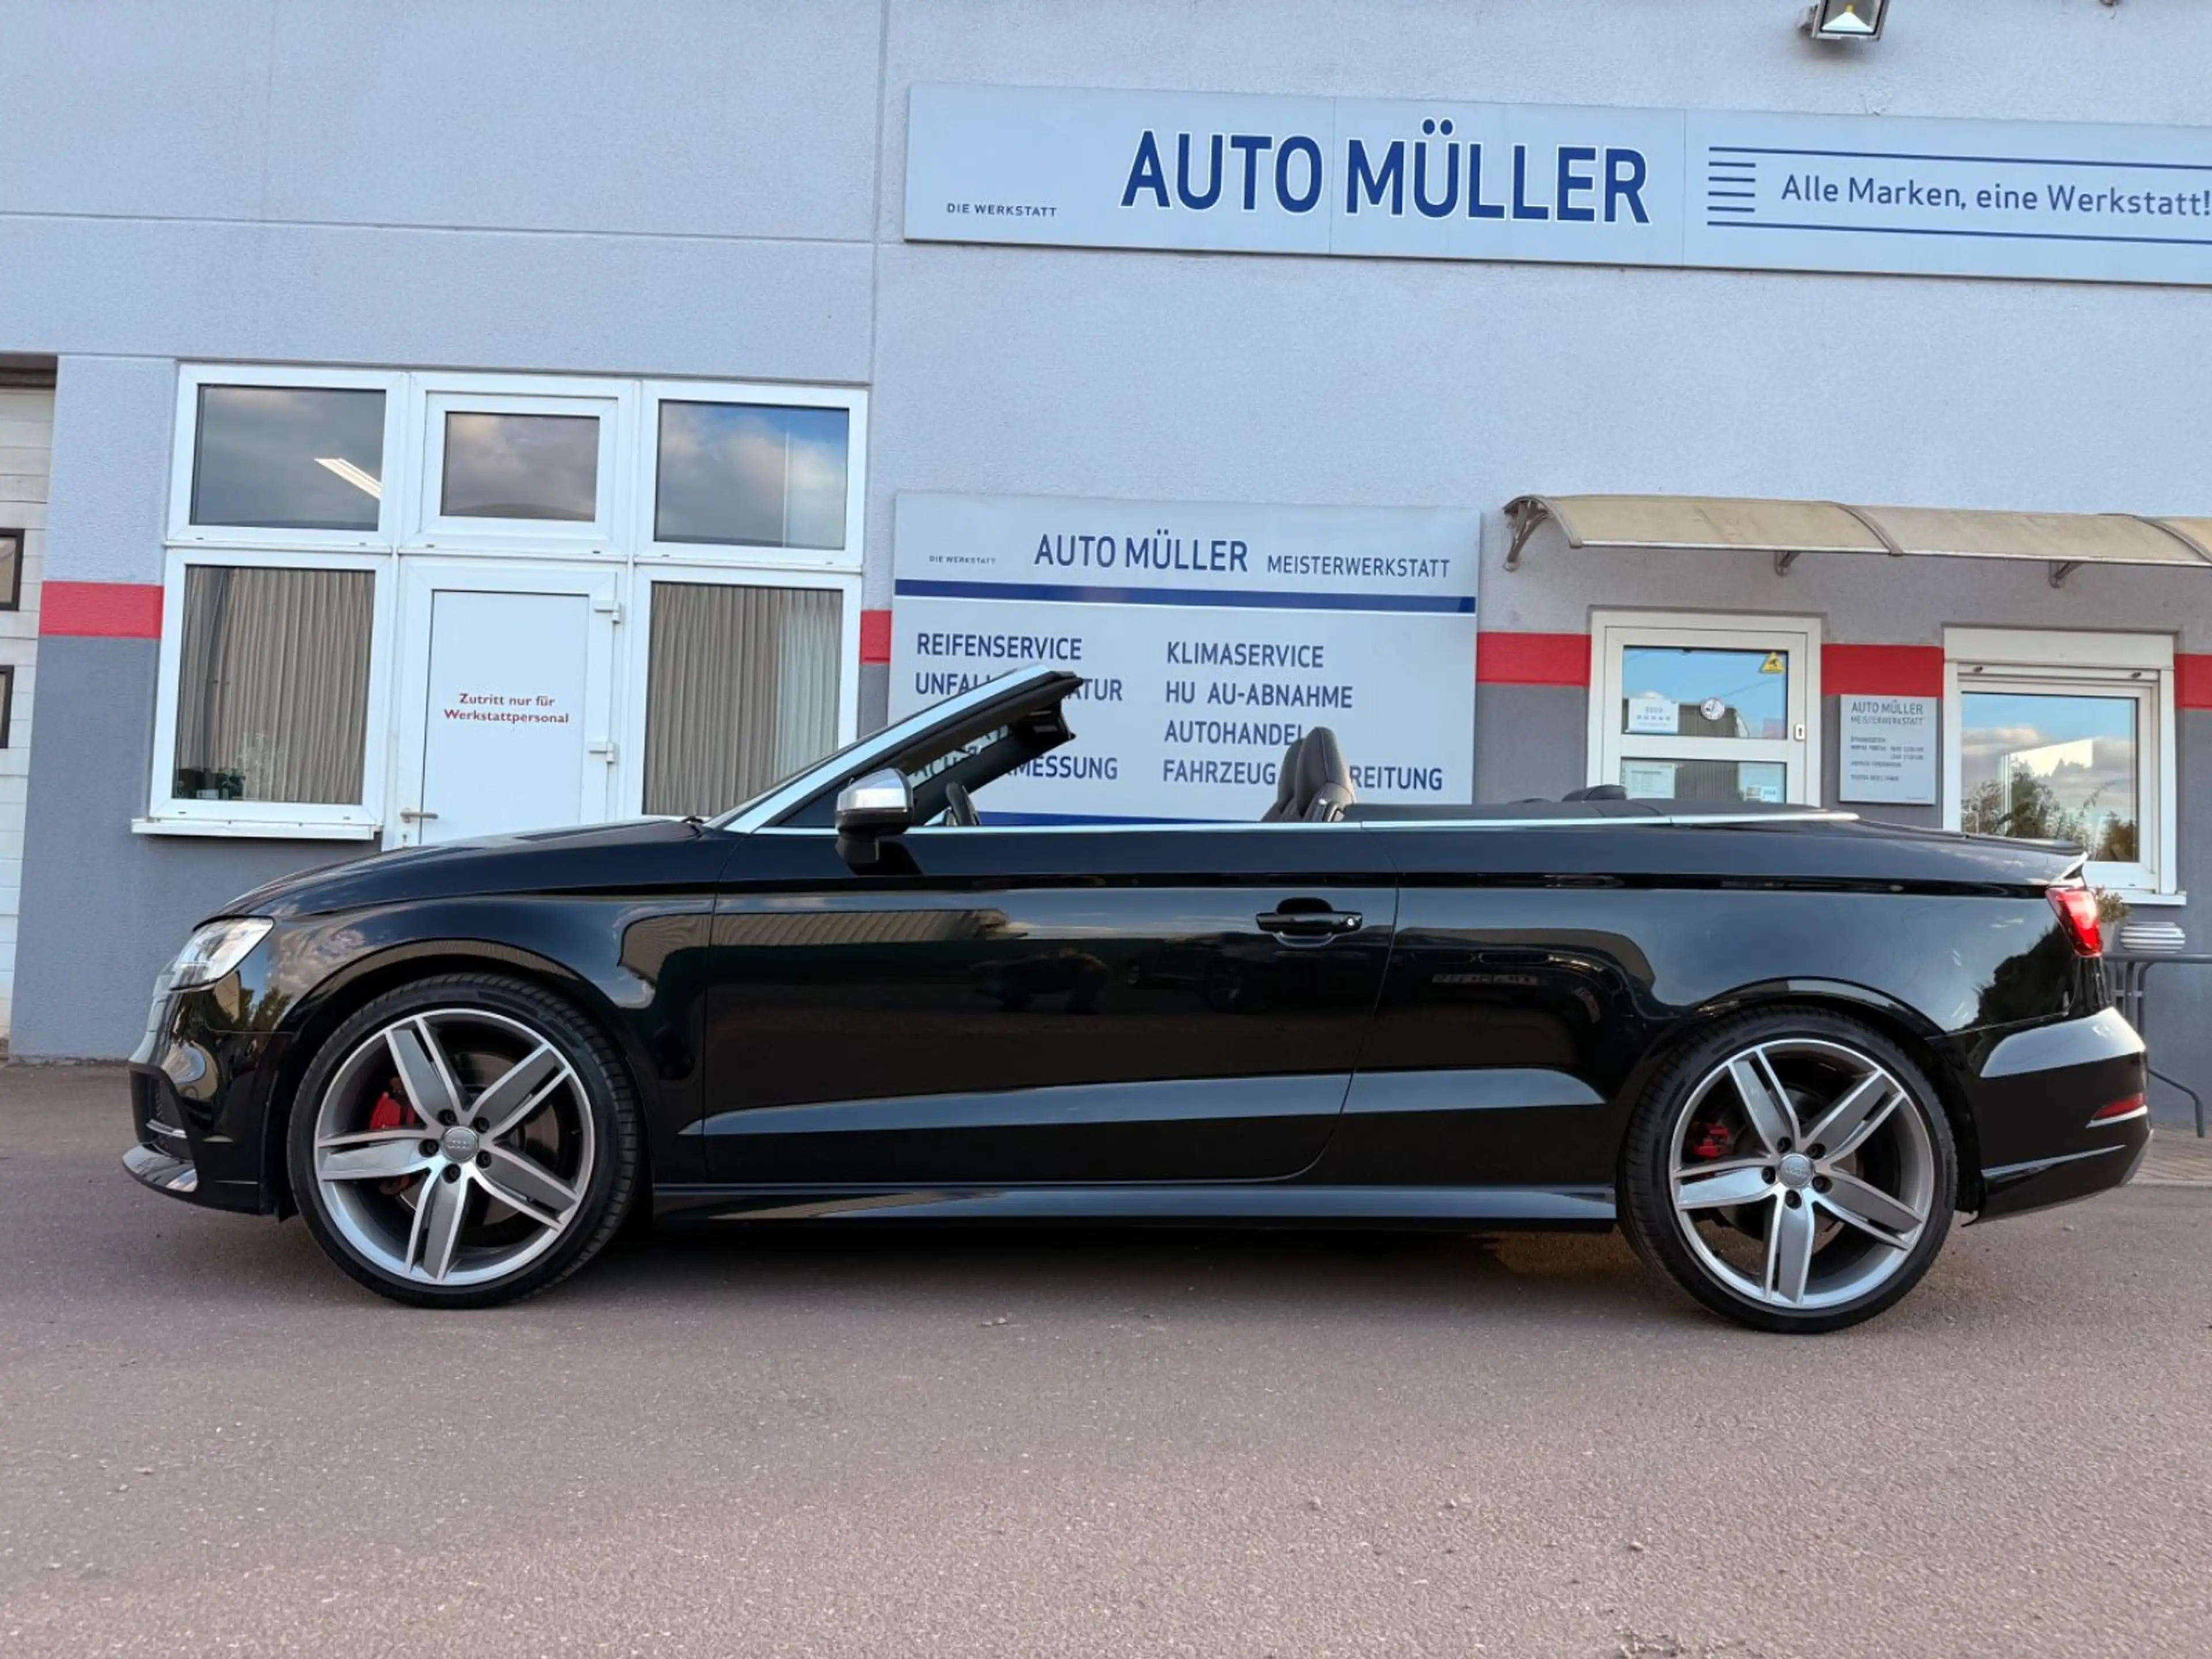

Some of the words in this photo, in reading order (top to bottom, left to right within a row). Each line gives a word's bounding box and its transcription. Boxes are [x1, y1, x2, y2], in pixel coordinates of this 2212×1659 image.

[1120, 130, 1323, 214] AUTO
[1346, 118, 1650, 224] MÜLLER
[1781, 173, 1839, 203] Alle
[1848, 176, 1967, 211] Marken,
[1976, 182, 2038, 210] eine
[2046, 184, 2211, 217] Werkstatt!
[946, 202, 970, 214] DIE
[974, 204, 1058, 218] WERKSTATT
[929, 555, 944, 563] DIE
[1034, 533, 1116, 568] AUTO
[1125, 528, 1248, 572] MÜLLER
[1267, 554, 1450, 578] MEISTERWERKSTATT
[916, 632, 1082, 661] REIFENSERVICE
[1166, 641, 1324, 668] KLIMASERVICE
[459, 692, 505, 706] Zutritt
[508, 697, 532, 706] nur
[535, 694, 556, 707] für
[1165, 680, 1196, 704] HU
[1206, 682, 1354, 709] AU-ABNAHME
[443, 709, 570, 725] Werkstattpersonal
[1851, 700, 1880, 714] AUTO
[1880, 699, 1924, 715] MÜLLER
[1850, 715, 1925, 726] MEISTERWERKSTATT
